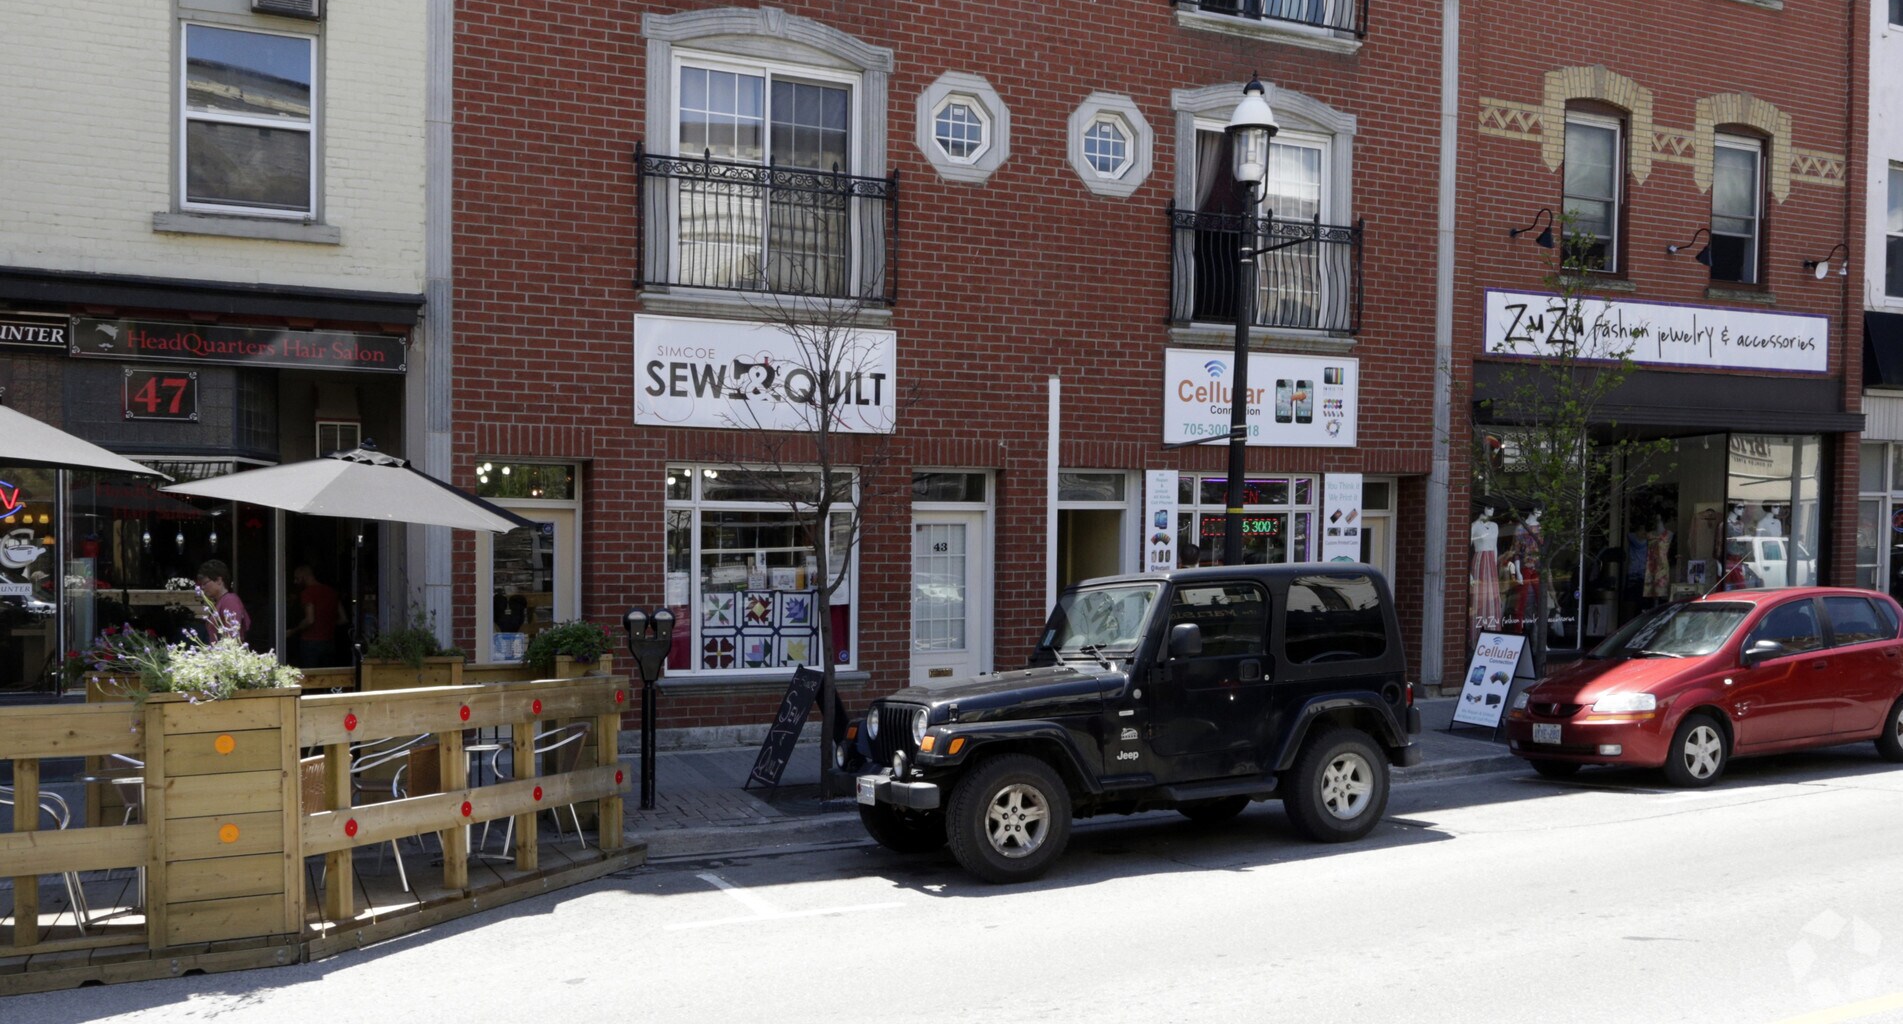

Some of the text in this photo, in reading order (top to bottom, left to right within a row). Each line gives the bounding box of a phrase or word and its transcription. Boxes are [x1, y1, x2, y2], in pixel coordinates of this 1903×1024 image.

[1504, 303, 1815, 358] ZuZu fashion jewelry & accessories
[127, 330, 385, 363] HeadQuarters Hair Salon
[657, 345, 715, 360] SIMCOE
[645, 360, 727, 399] SEW
[784, 367, 886, 406] QUILT
[134, 377, 188, 414] 47
[1178, 379, 1265, 404] Celluar
[1210, 405, 1261, 416] Connion
[933, 542, 948, 552] 43
[1475, 616, 1500, 629] ZuZu
[1477, 644, 1520, 660] Cellular
[1116, 750, 1139, 760] Jeep
